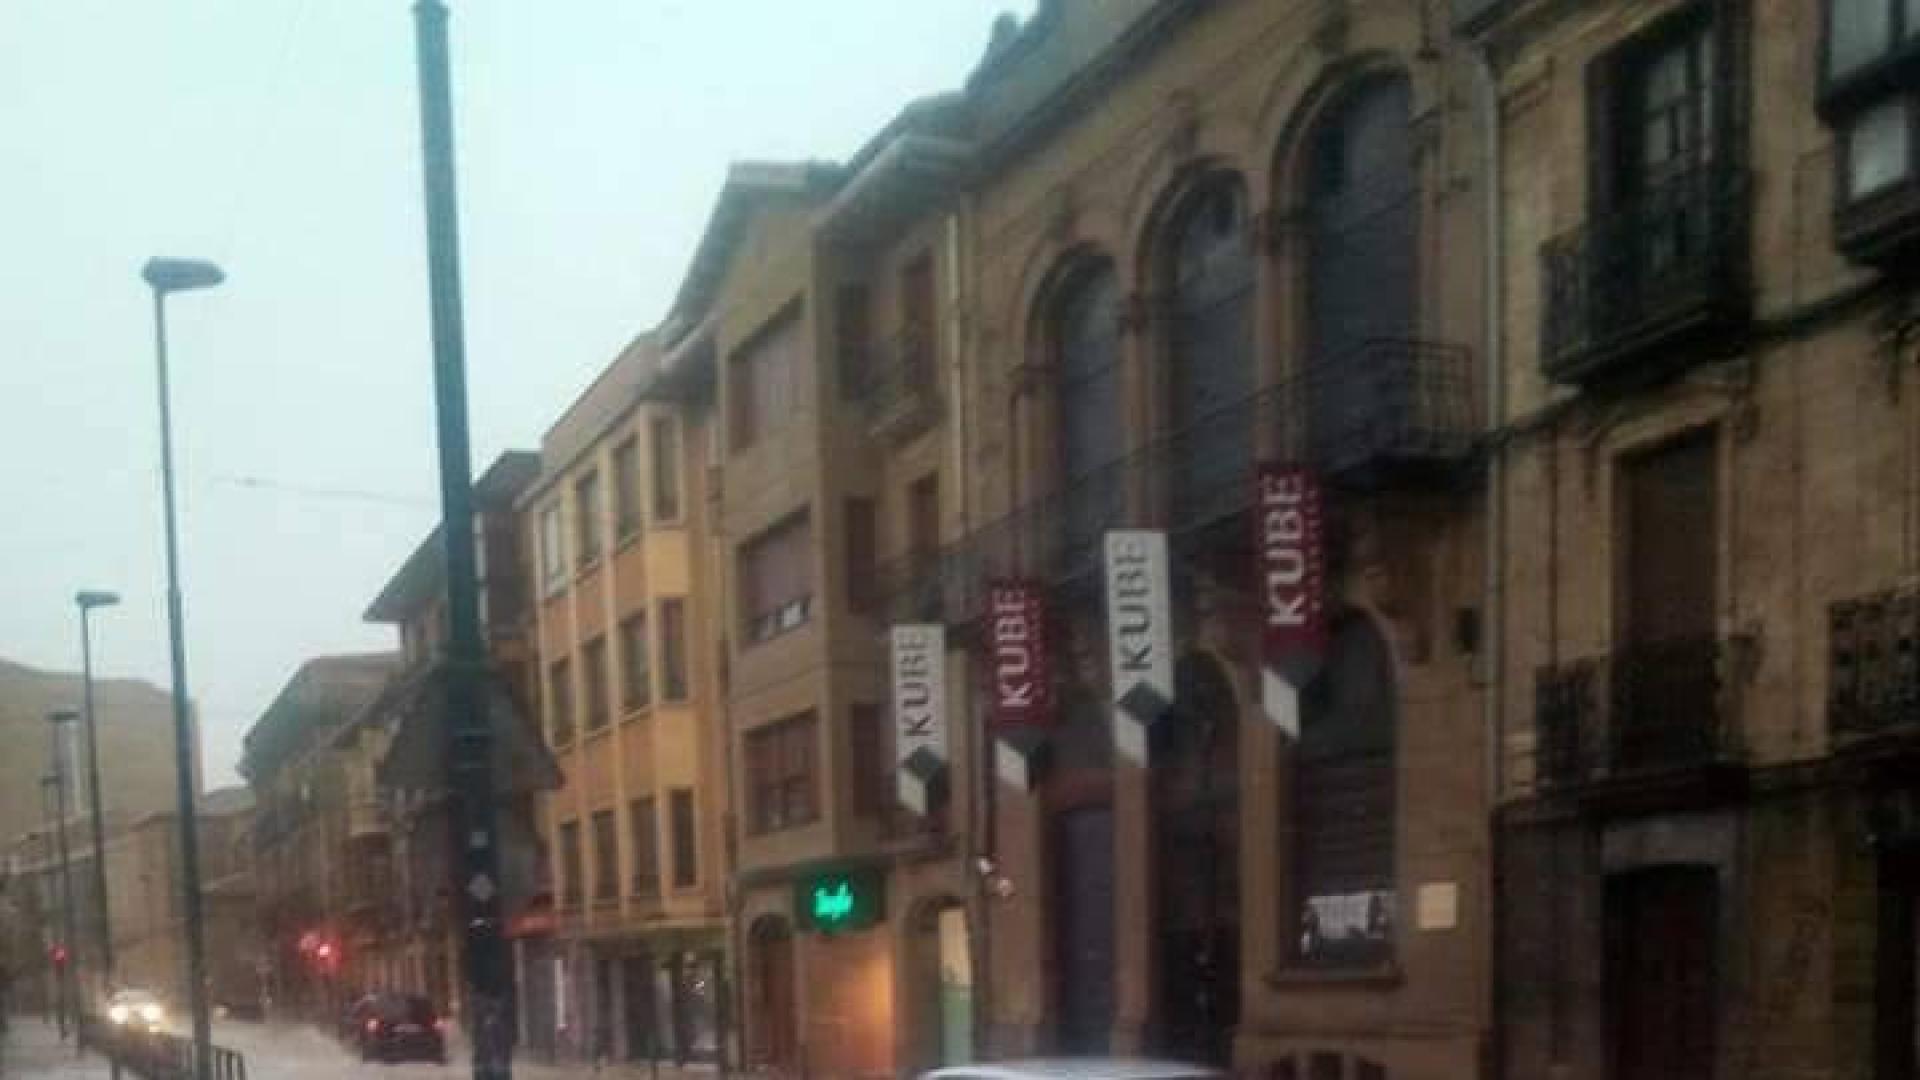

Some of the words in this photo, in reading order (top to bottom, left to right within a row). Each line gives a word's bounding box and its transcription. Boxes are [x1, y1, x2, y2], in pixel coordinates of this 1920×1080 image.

[1114, 537, 1153, 672] KUBE
[1264, 472, 1307, 625] KUBE
[899, 630, 933, 738] KUBE
[993, 585, 1033, 707] KUBE
